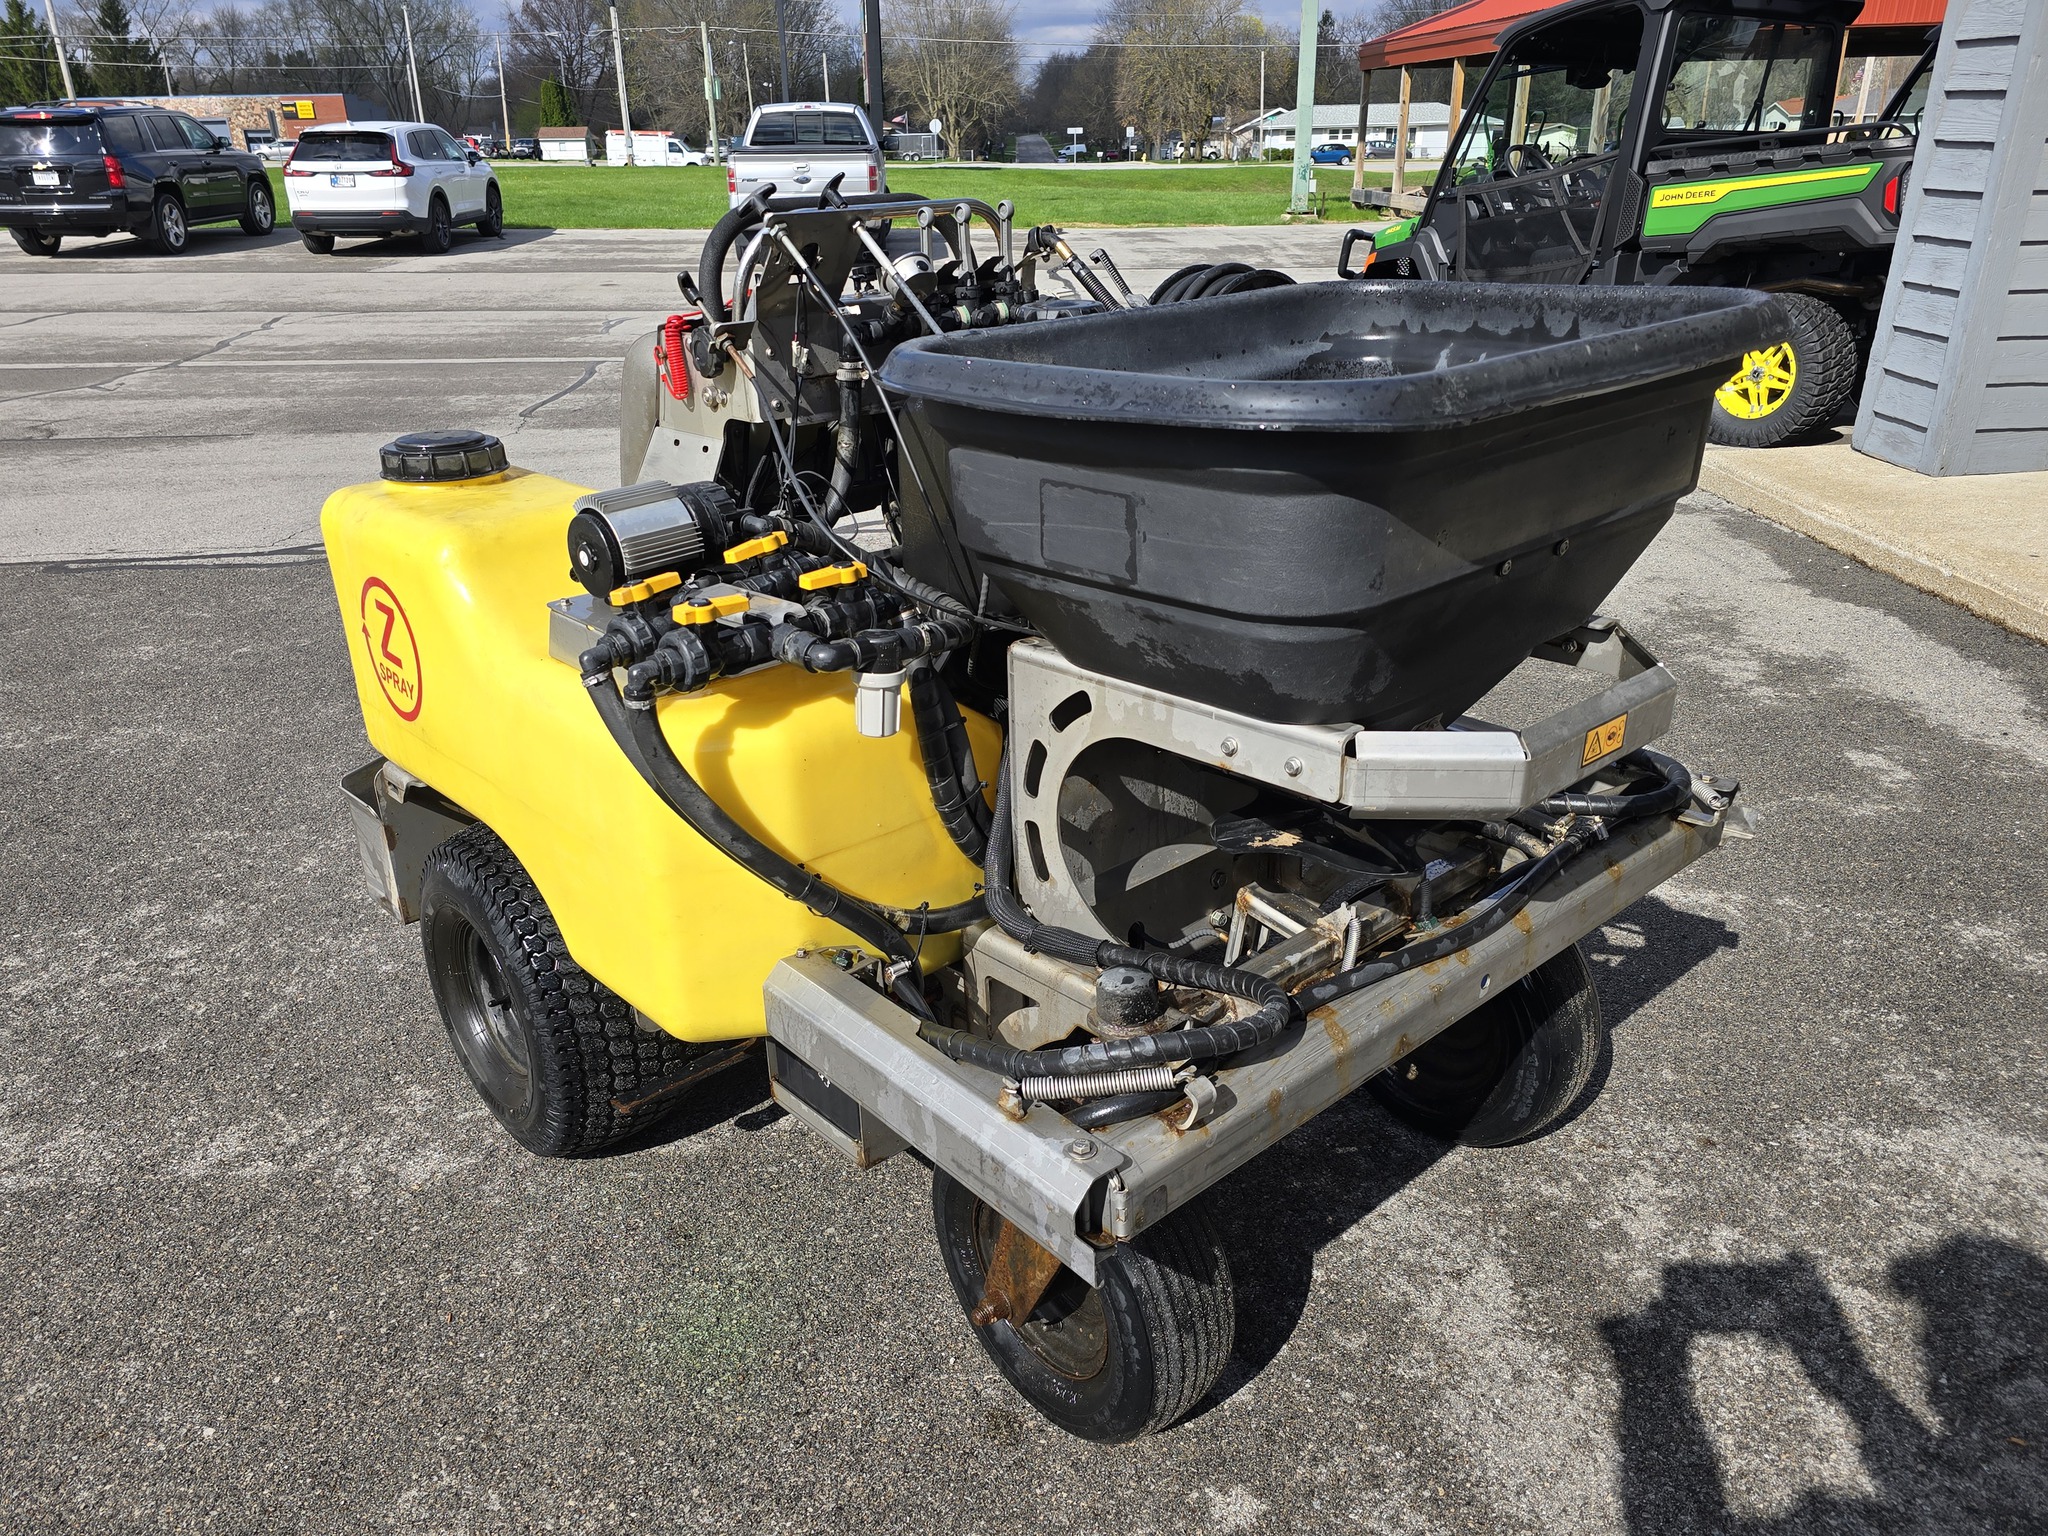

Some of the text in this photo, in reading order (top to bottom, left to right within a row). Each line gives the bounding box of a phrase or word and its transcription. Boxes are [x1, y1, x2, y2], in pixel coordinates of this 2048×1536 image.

[1660, 190, 1716, 201] JOHN DEERE
[375, 598, 403, 670] Z
[379, 662, 414, 700] SPRAY
